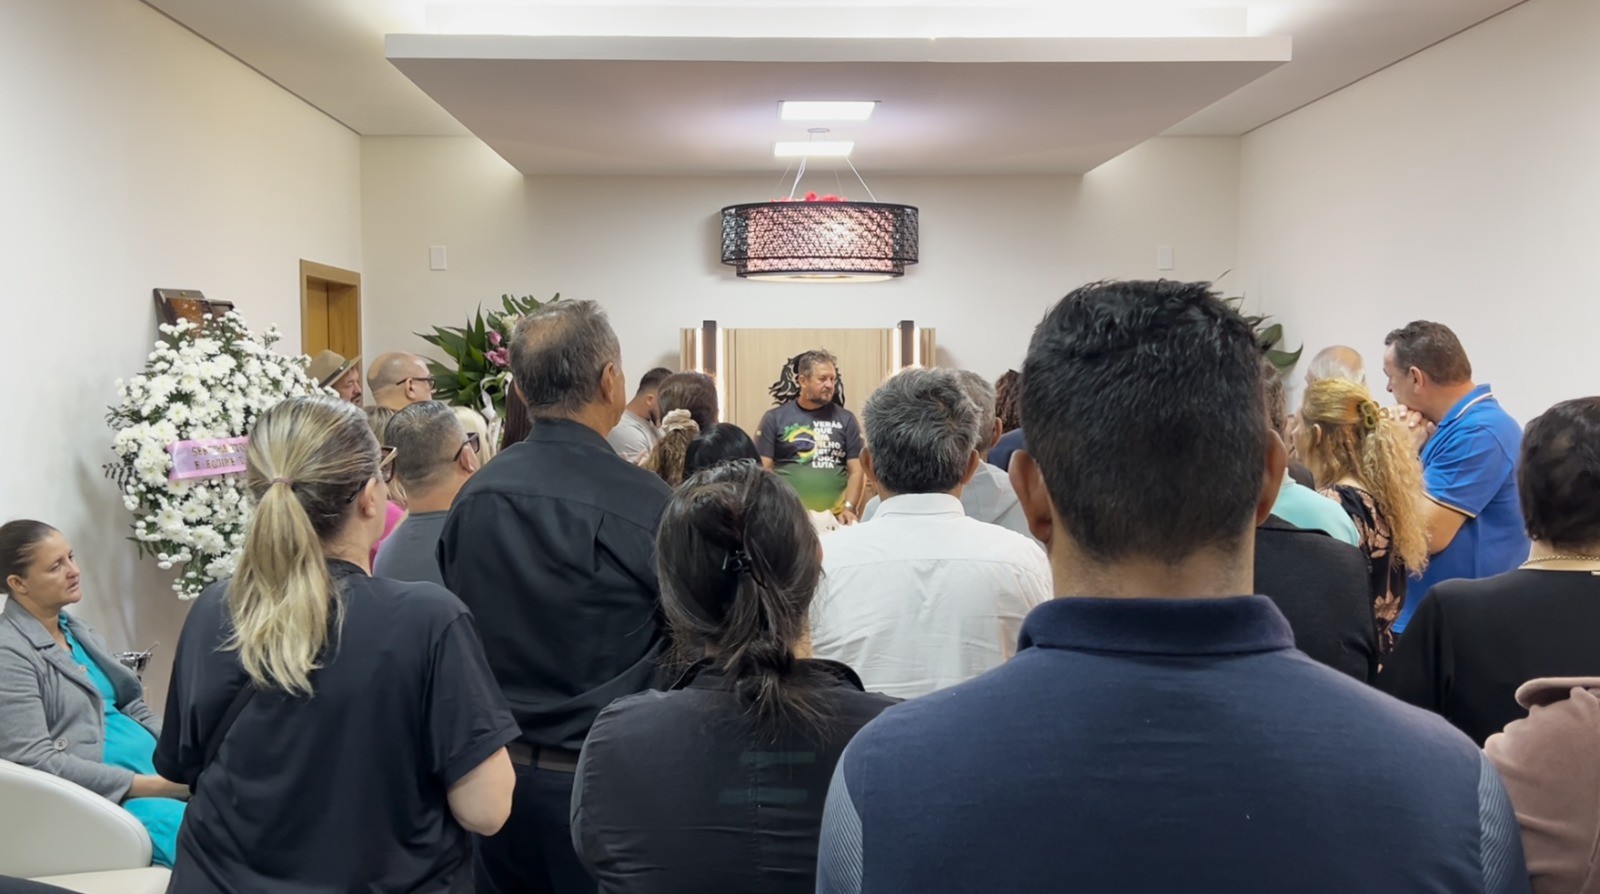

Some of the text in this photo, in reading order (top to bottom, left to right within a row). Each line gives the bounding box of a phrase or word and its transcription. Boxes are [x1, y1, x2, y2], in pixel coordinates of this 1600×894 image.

[813, 420, 843, 429] VERÁS
[813, 427, 833, 435] QUE
[812, 461, 834, 469] LUTA
